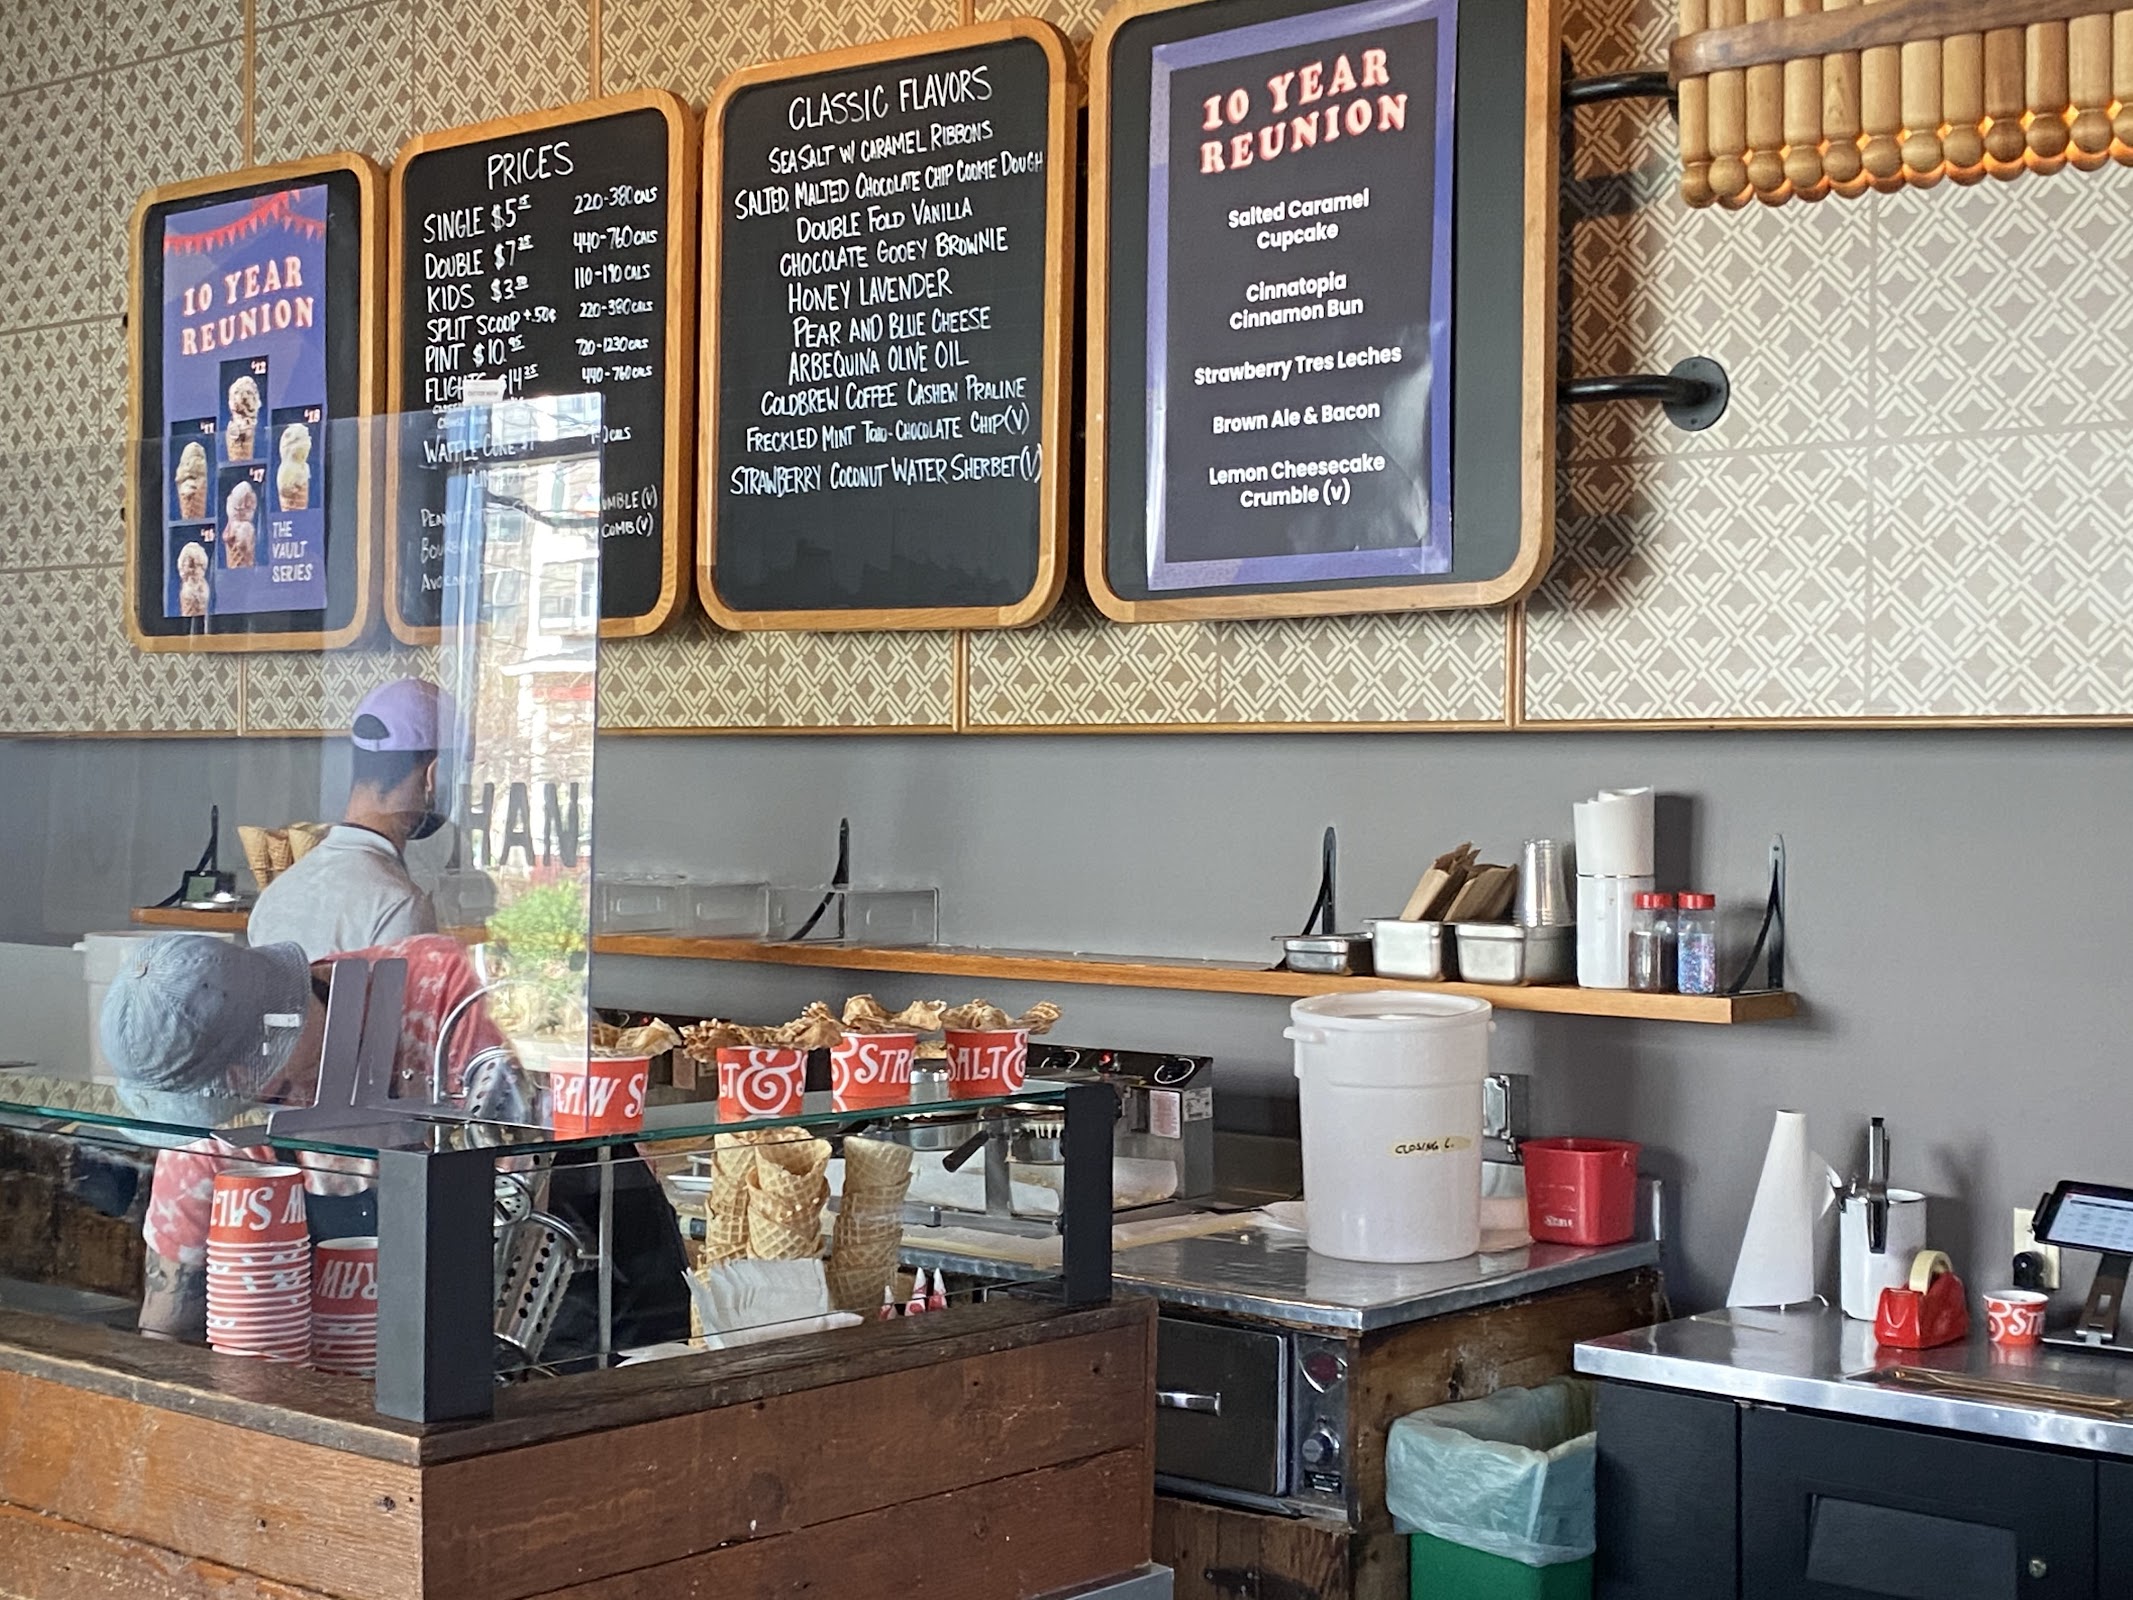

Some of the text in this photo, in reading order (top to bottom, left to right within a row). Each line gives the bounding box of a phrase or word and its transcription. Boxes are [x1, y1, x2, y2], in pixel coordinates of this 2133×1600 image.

[789, 65, 992, 131] CLASSIC FLAVORS
[1202, 48, 1390, 131] 10 YEAR
[861, 129, 927, 162] CARAMEL
[931, 120, 993, 151] RIBBONS
[1200, 93, 1408, 174] REUNION
[487, 141, 574, 190] PRICES
[795, 179, 850, 210] MALTED
[855, 170, 921, 199] CHOCOLATE
[925, 164, 954, 190] CHIP
[957, 157, 998, 183] COOKIE
[1000, 150, 1044, 176] DOUGH
[423, 206, 485, 243] SINGLE
[796, 197, 973, 243] DOUBLE FOLD VANILLA
[1228, 187, 1370, 228] Salted Caramel
[780, 226, 1008, 278] CHOCOLATE GOOEY BROWNIE
[1257, 221, 1339, 252] Cupcake
[425, 249, 484, 280] DOUBLE
[183, 256, 303, 316] 10 YEAR
[426, 283, 475, 313] KIDS
[788, 268, 953, 314] HONEY LAVENDER
[1246, 270, 1347, 303] Cinnatopia
[182, 297, 315, 355] REUNION
[426, 315, 473, 343] SPLIT
[476, 311, 521, 336] SCOOP
[792, 306, 992, 349] PEAR AND BLUE CHEESE
[1229, 298, 1364, 331] Cinnamon Bun
[425, 343, 466, 373] PINT
[788, 340, 969, 386] ARBEQUINA OLIVE OIL
[1194, 345, 1403, 386] Strawberry Tres Leches
[760, 374, 1027, 417] COLDBREW COFFEE CASHEW PRALINE
[1213, 402, 1381, 435] Brown Ale & Bacon
[423, 434, 480, 463] WAFFLE
[747, 426, 818, 453] FRECKLED
[823, 424, 857, 453] MINT
[730, 464, 822, 498] STRAWBERRY
[830, 462, 889, 489] COCONUT
[891, 455, 949, 486] WATER
[1209, 453, 1385, 486] Lemon Cheesecake
[1240, 478, 1351, 508] Crumble (v)
[272, 521, 292, 537] THE
[272, 541, 308, 558] VAULT
[272, 564, 313, 583] SERIES
[1395, 1141, 1439, 1154] CLOSING
